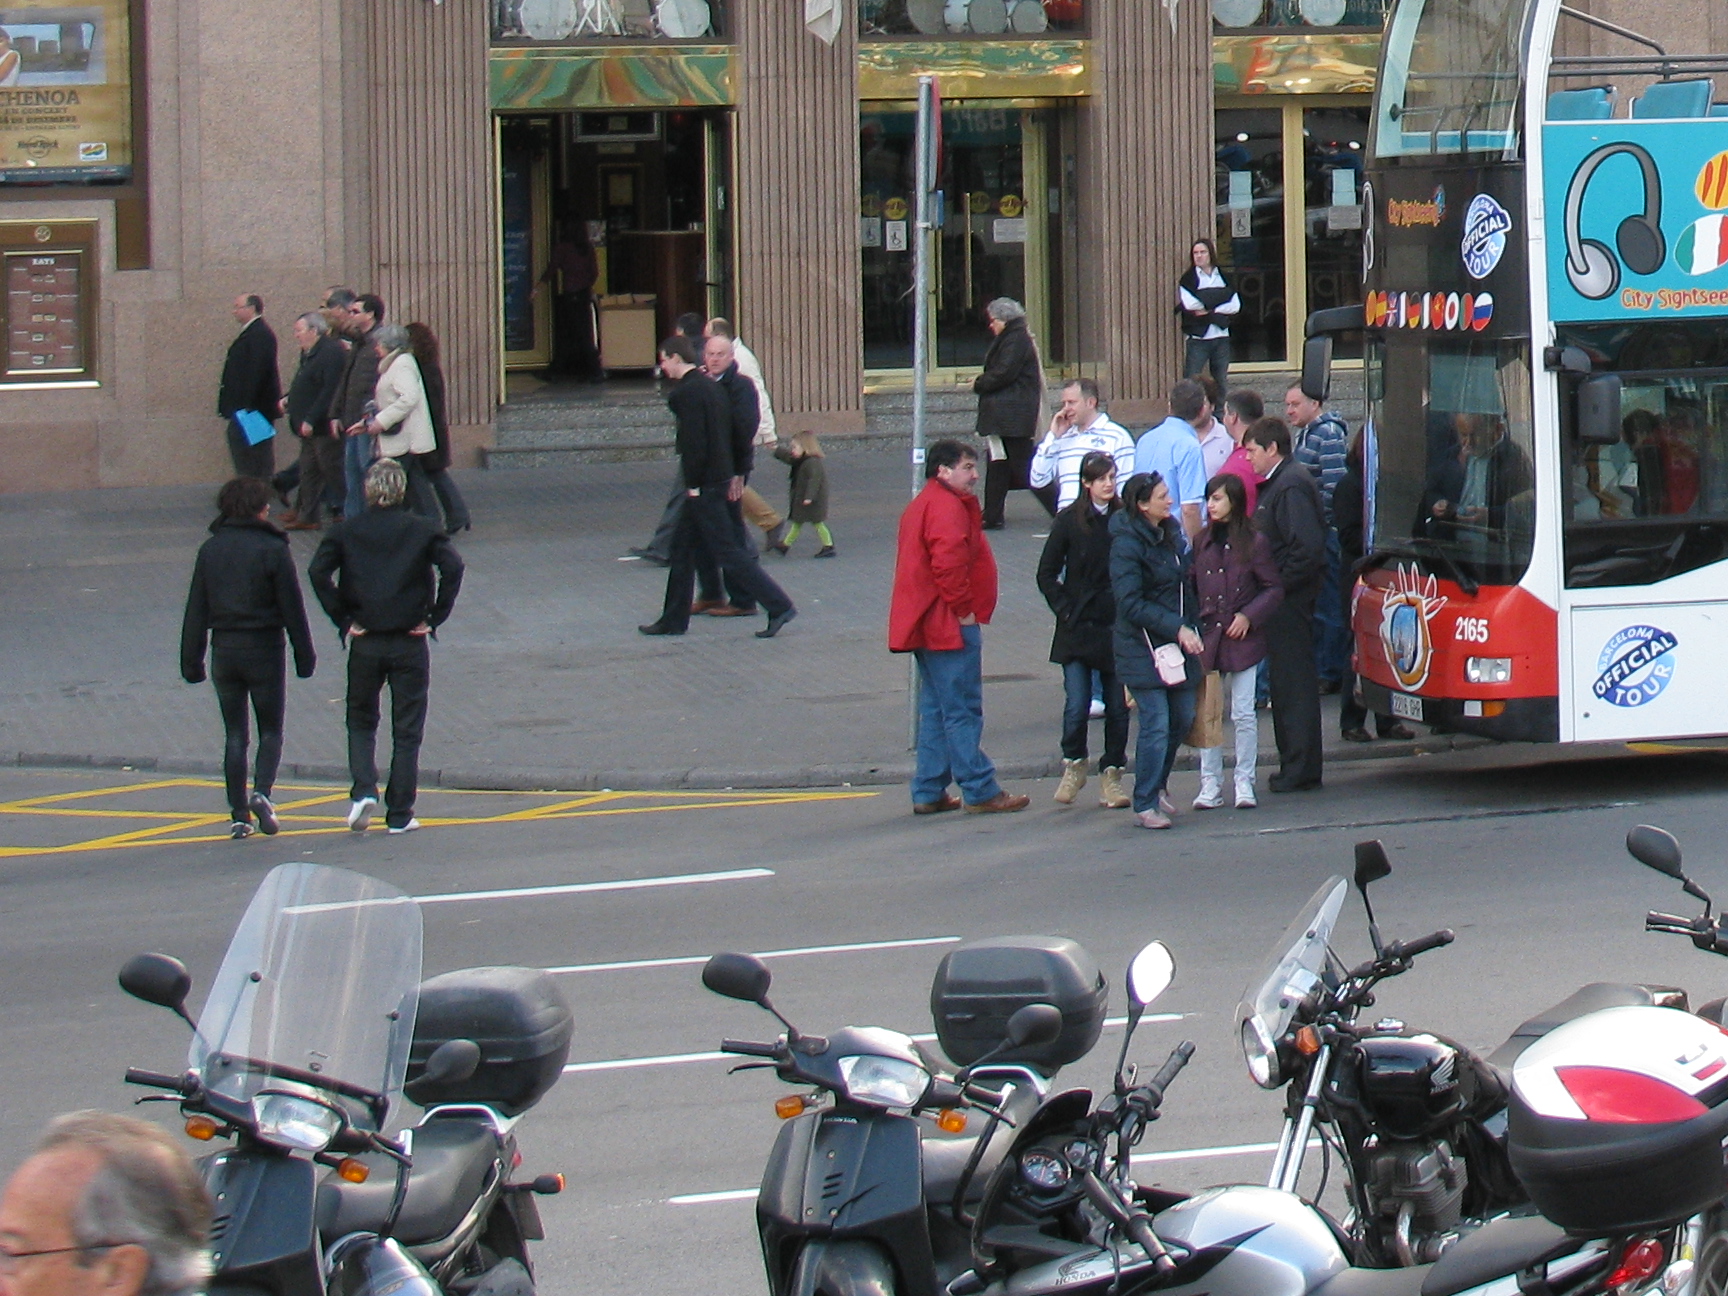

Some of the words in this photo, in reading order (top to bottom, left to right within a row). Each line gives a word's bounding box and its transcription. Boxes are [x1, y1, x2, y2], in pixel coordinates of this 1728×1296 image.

[1463, 217, 1504, 254] OFFICIAL
[1469, 242, 1499, 274] TOUR
[1622, 288, 1653, 310] City
[1455, 616, 1489, 642] 2165
[1596, 636, 1673, 695] OFFICIAL
[1600, 628, 1654, 671] BARCELONA
[1615, 664, 1672, 705] TOUR
[1056, 1271, 1097, 1286] HONDA
